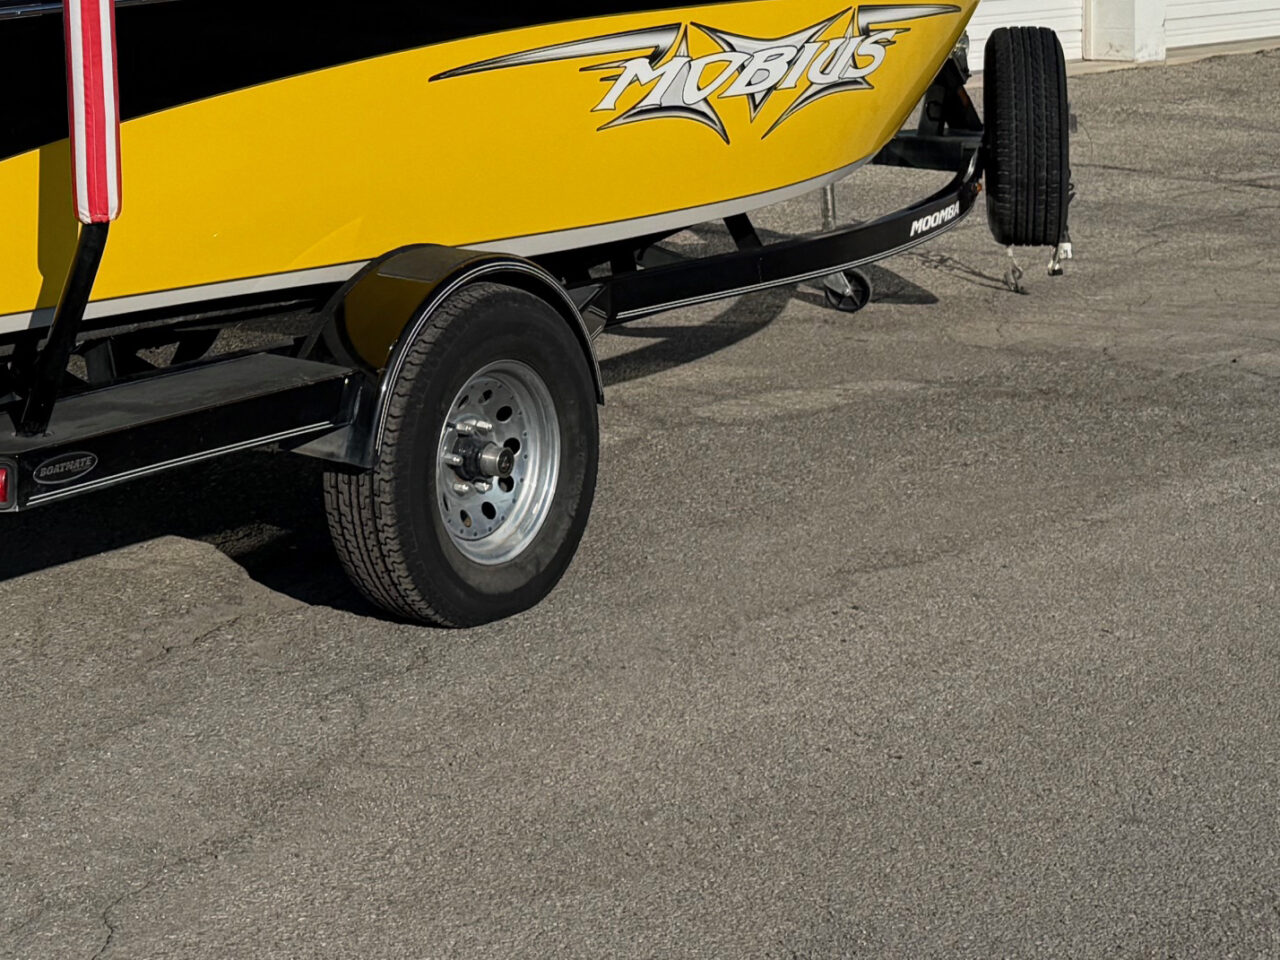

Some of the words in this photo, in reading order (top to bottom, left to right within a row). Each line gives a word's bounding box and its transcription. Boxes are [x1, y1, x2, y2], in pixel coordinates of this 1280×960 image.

[590, 29, 898, 112] MOBIUS
[909, 200, 960, 237] MOOMBA
[39, 455, 93, 478] BOATMATE
